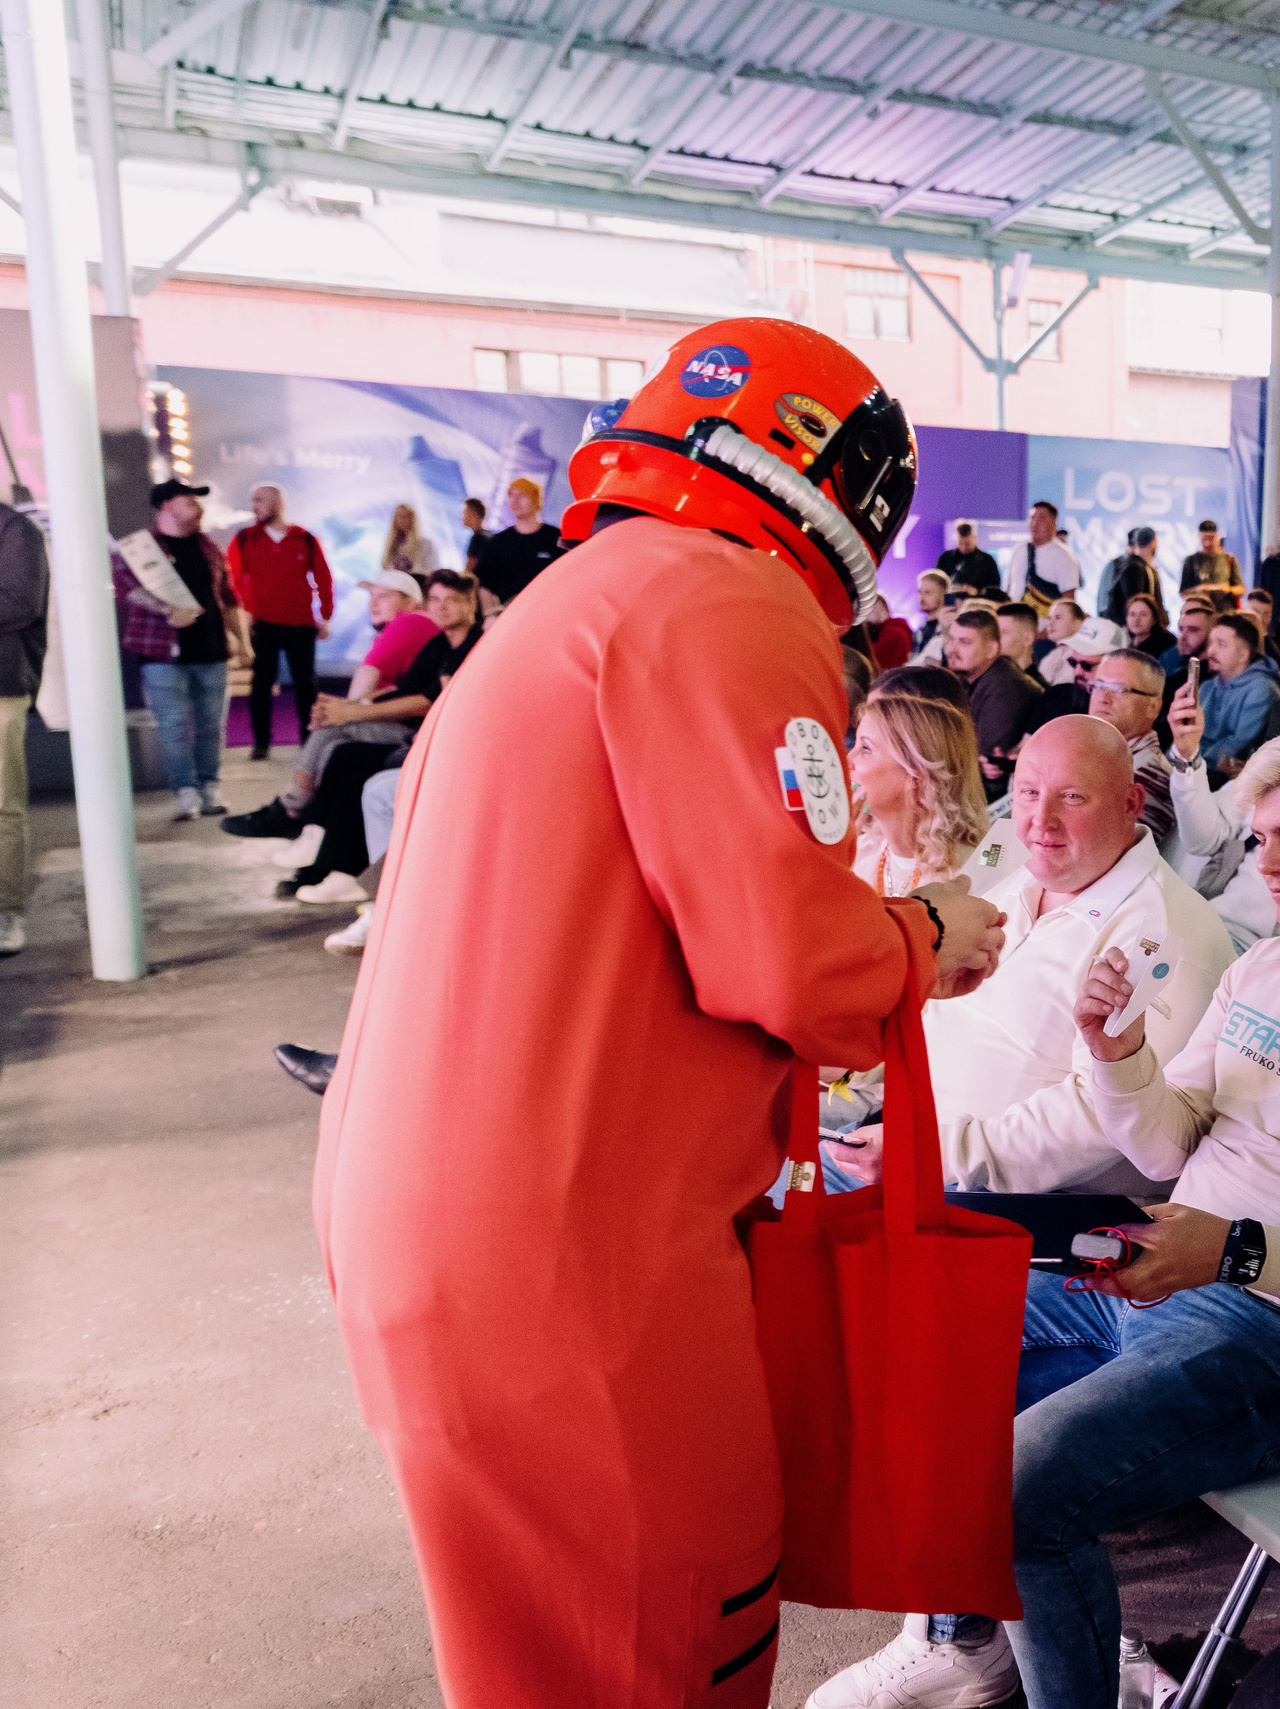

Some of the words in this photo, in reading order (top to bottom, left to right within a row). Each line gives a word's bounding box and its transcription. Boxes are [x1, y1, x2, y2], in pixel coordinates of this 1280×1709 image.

[686, 360, 743, 387] NASA
[793, 396, 839, 428] POWER
[784, 414, 821, 450] VISOR
[1064, 467, 1208, 517] LOST
[1239, 1045, 1276, 1071] FRUKO
